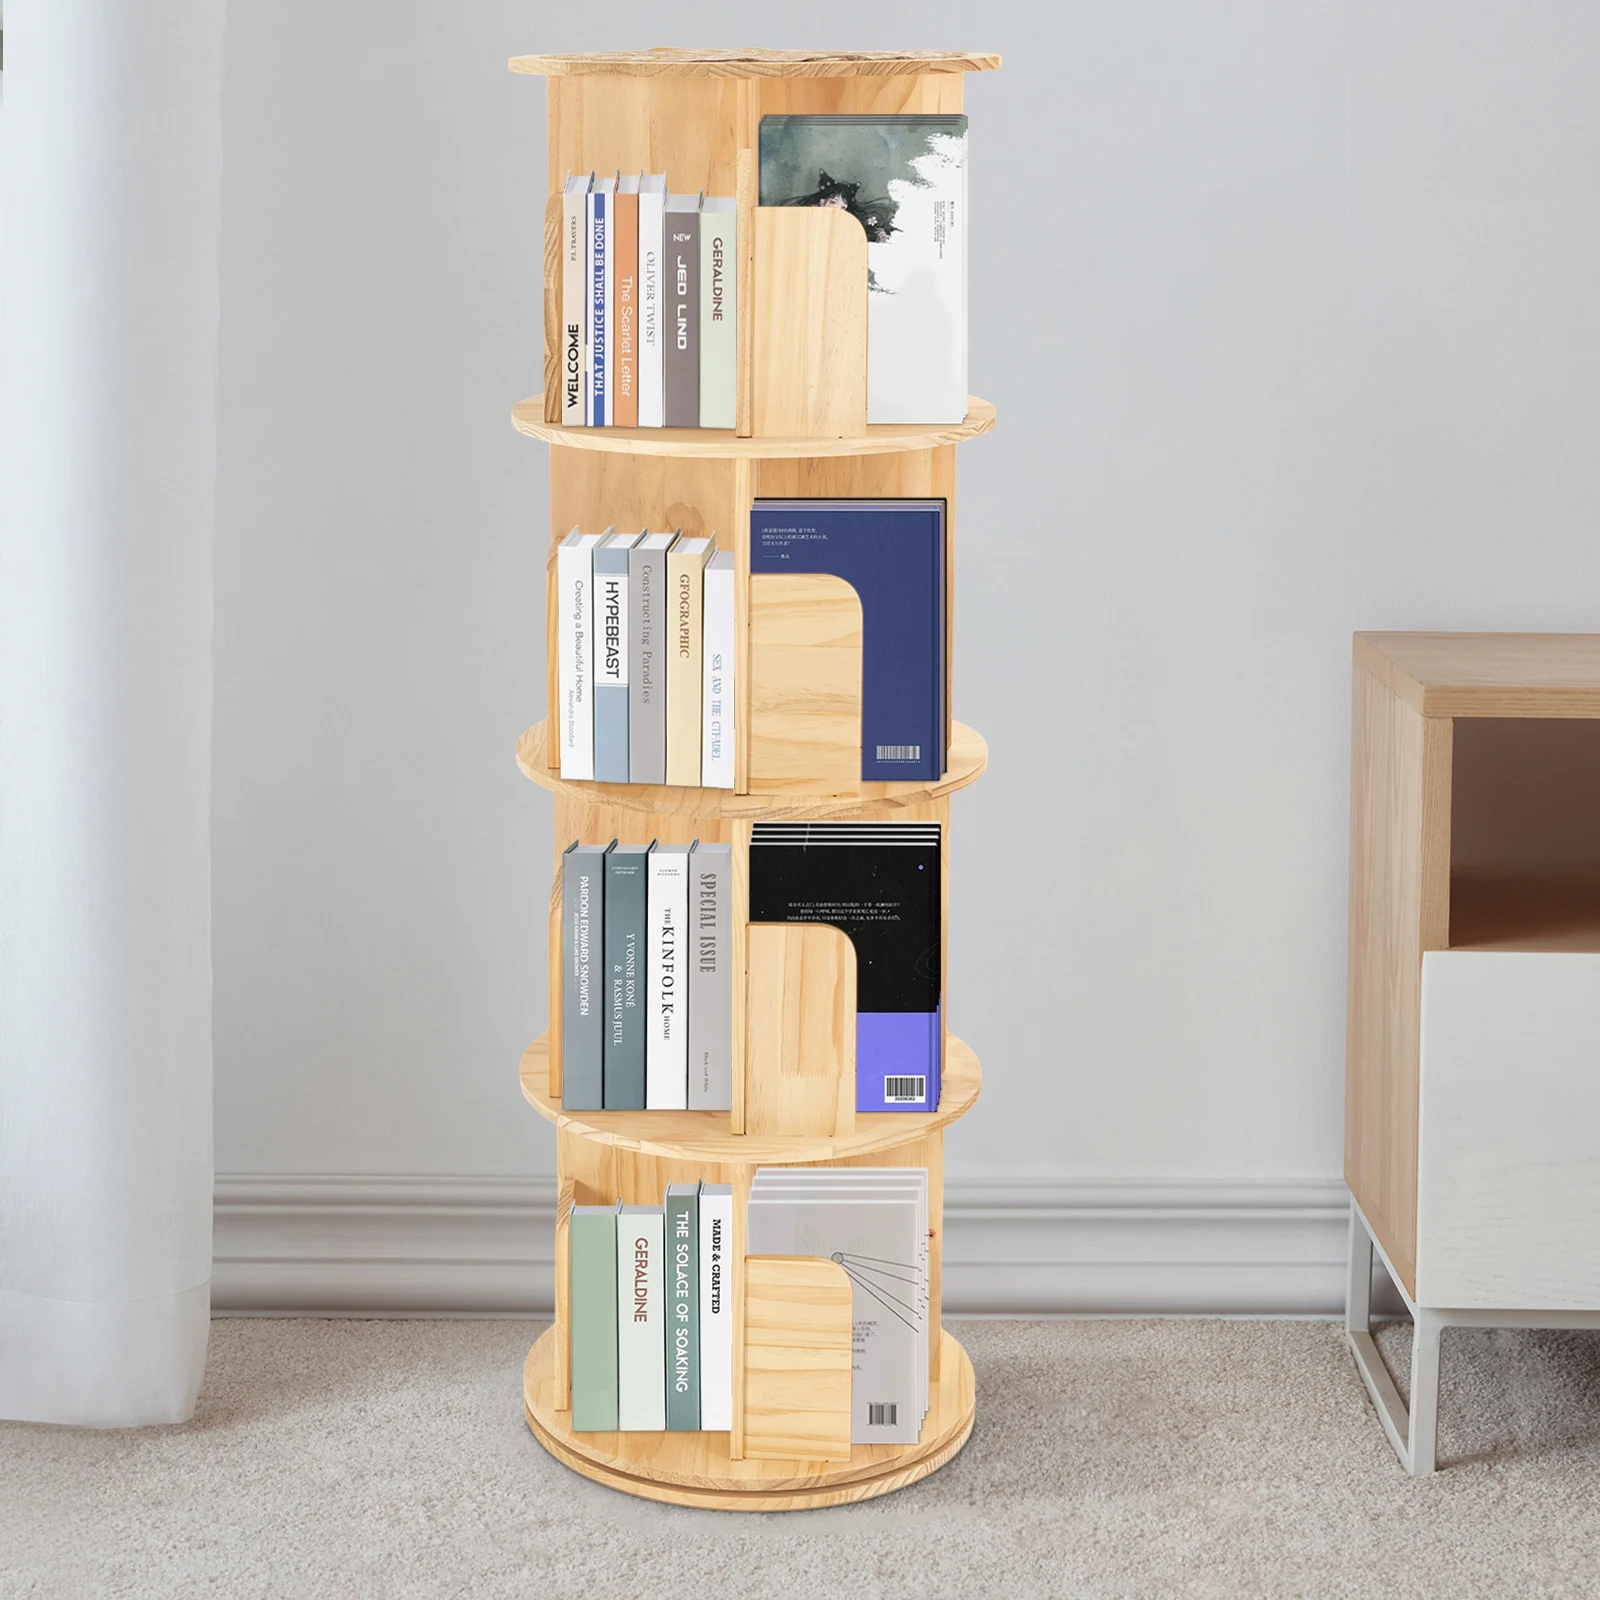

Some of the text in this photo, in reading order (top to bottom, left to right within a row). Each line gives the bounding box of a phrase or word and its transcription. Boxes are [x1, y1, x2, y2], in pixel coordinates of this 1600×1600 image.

[673, 232, 692, 243] NEW
[712, 237, 723, 322] GERALDINE
[594, 217, 604, 397] THAT JUSTICE SHALL BE DONE
[621, 275, 633, 398] The Scarlet Letter
[646, 251, 656, 347] OLIVER TWIST
[676, 255, 688, 350] JED LIND
[567, 324, 579, 408] WELCOME
[573, 580, 584, 620] Creating
[605, 581, 620, 679] HYPEBEAST
[641, 565, 653, 704] Constructing Paradies
[679, 573, 691, 659] GFOGRAPHIC
[575, 631, 584, 673] Beautiful
[575, 674, 584, 703] Home
[711, 676, 722, 695] AND
[712, 653, 723, 672] SEX
[711, 699, 722, 717] THE
[580, 875, 589, 1016] PARDON EDWARD SNOWDEN
[700, 873, 717, 973] SPECIAL ISSUE
[612, 964, 623, 1046] & RASMUS JUUL
[626, 979, 637, 1008] KONÉ
[661, 926, 675, 1014] KINFOLK
[663, 1015, 671, 1041] HOME
[634, 1237, 649, 1323] GERALDINE
[676, 1211, 689, 1393] THE SOLACE OF SOAKING
[711, 1219, 722, 1314] MADE & CRAFTED
